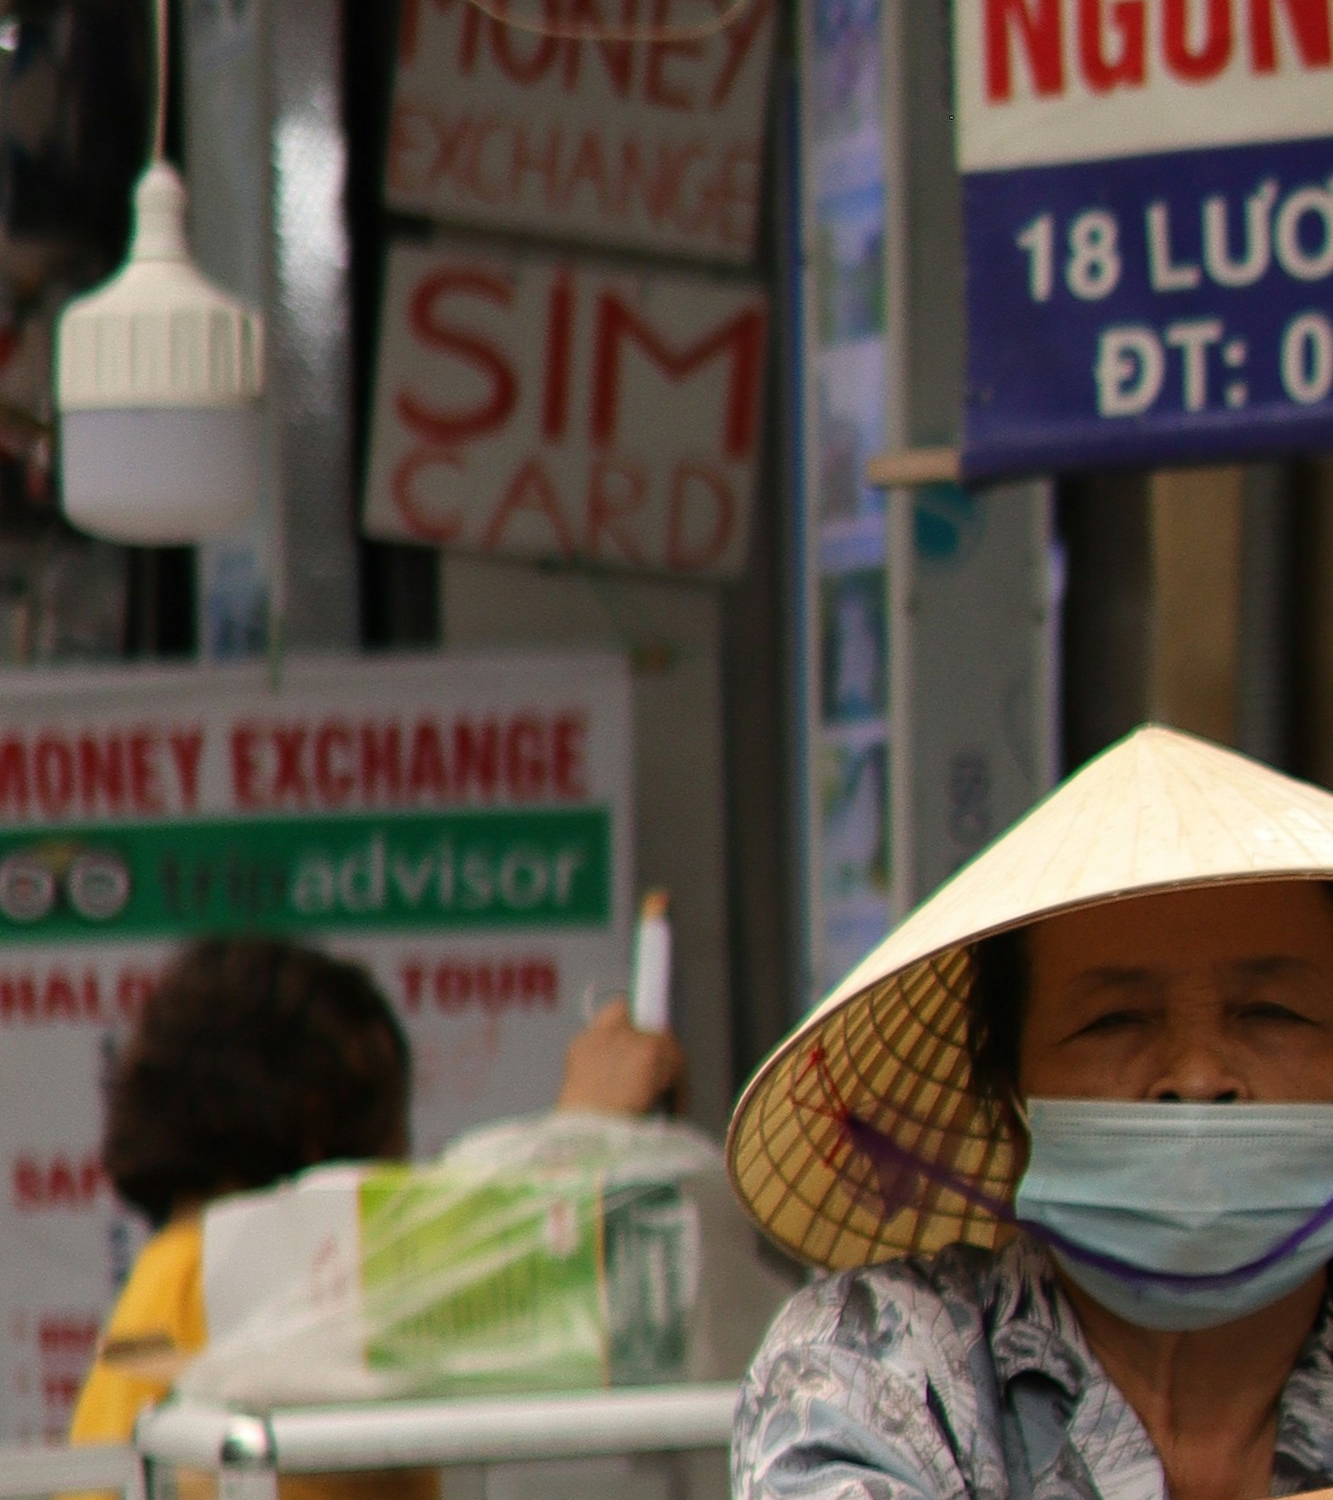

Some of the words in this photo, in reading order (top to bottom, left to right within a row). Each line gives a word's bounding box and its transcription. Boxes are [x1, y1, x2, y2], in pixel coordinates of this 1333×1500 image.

[390, 102, 762, 248] EXCHANGE
[1014, 212, 1120, 301] 18
[398, 258, 766, 464] SIM
[1094, 320, 1247, 419] ĐT:
[392, 441, 735, 572] CARD
[0, 718, 206, 818] MONEY
[228, 707, 590, 809] EXCHANGE
[156, 828, 588, 925] tripadvisor
[401, 956, 557, 1012] TOUR
